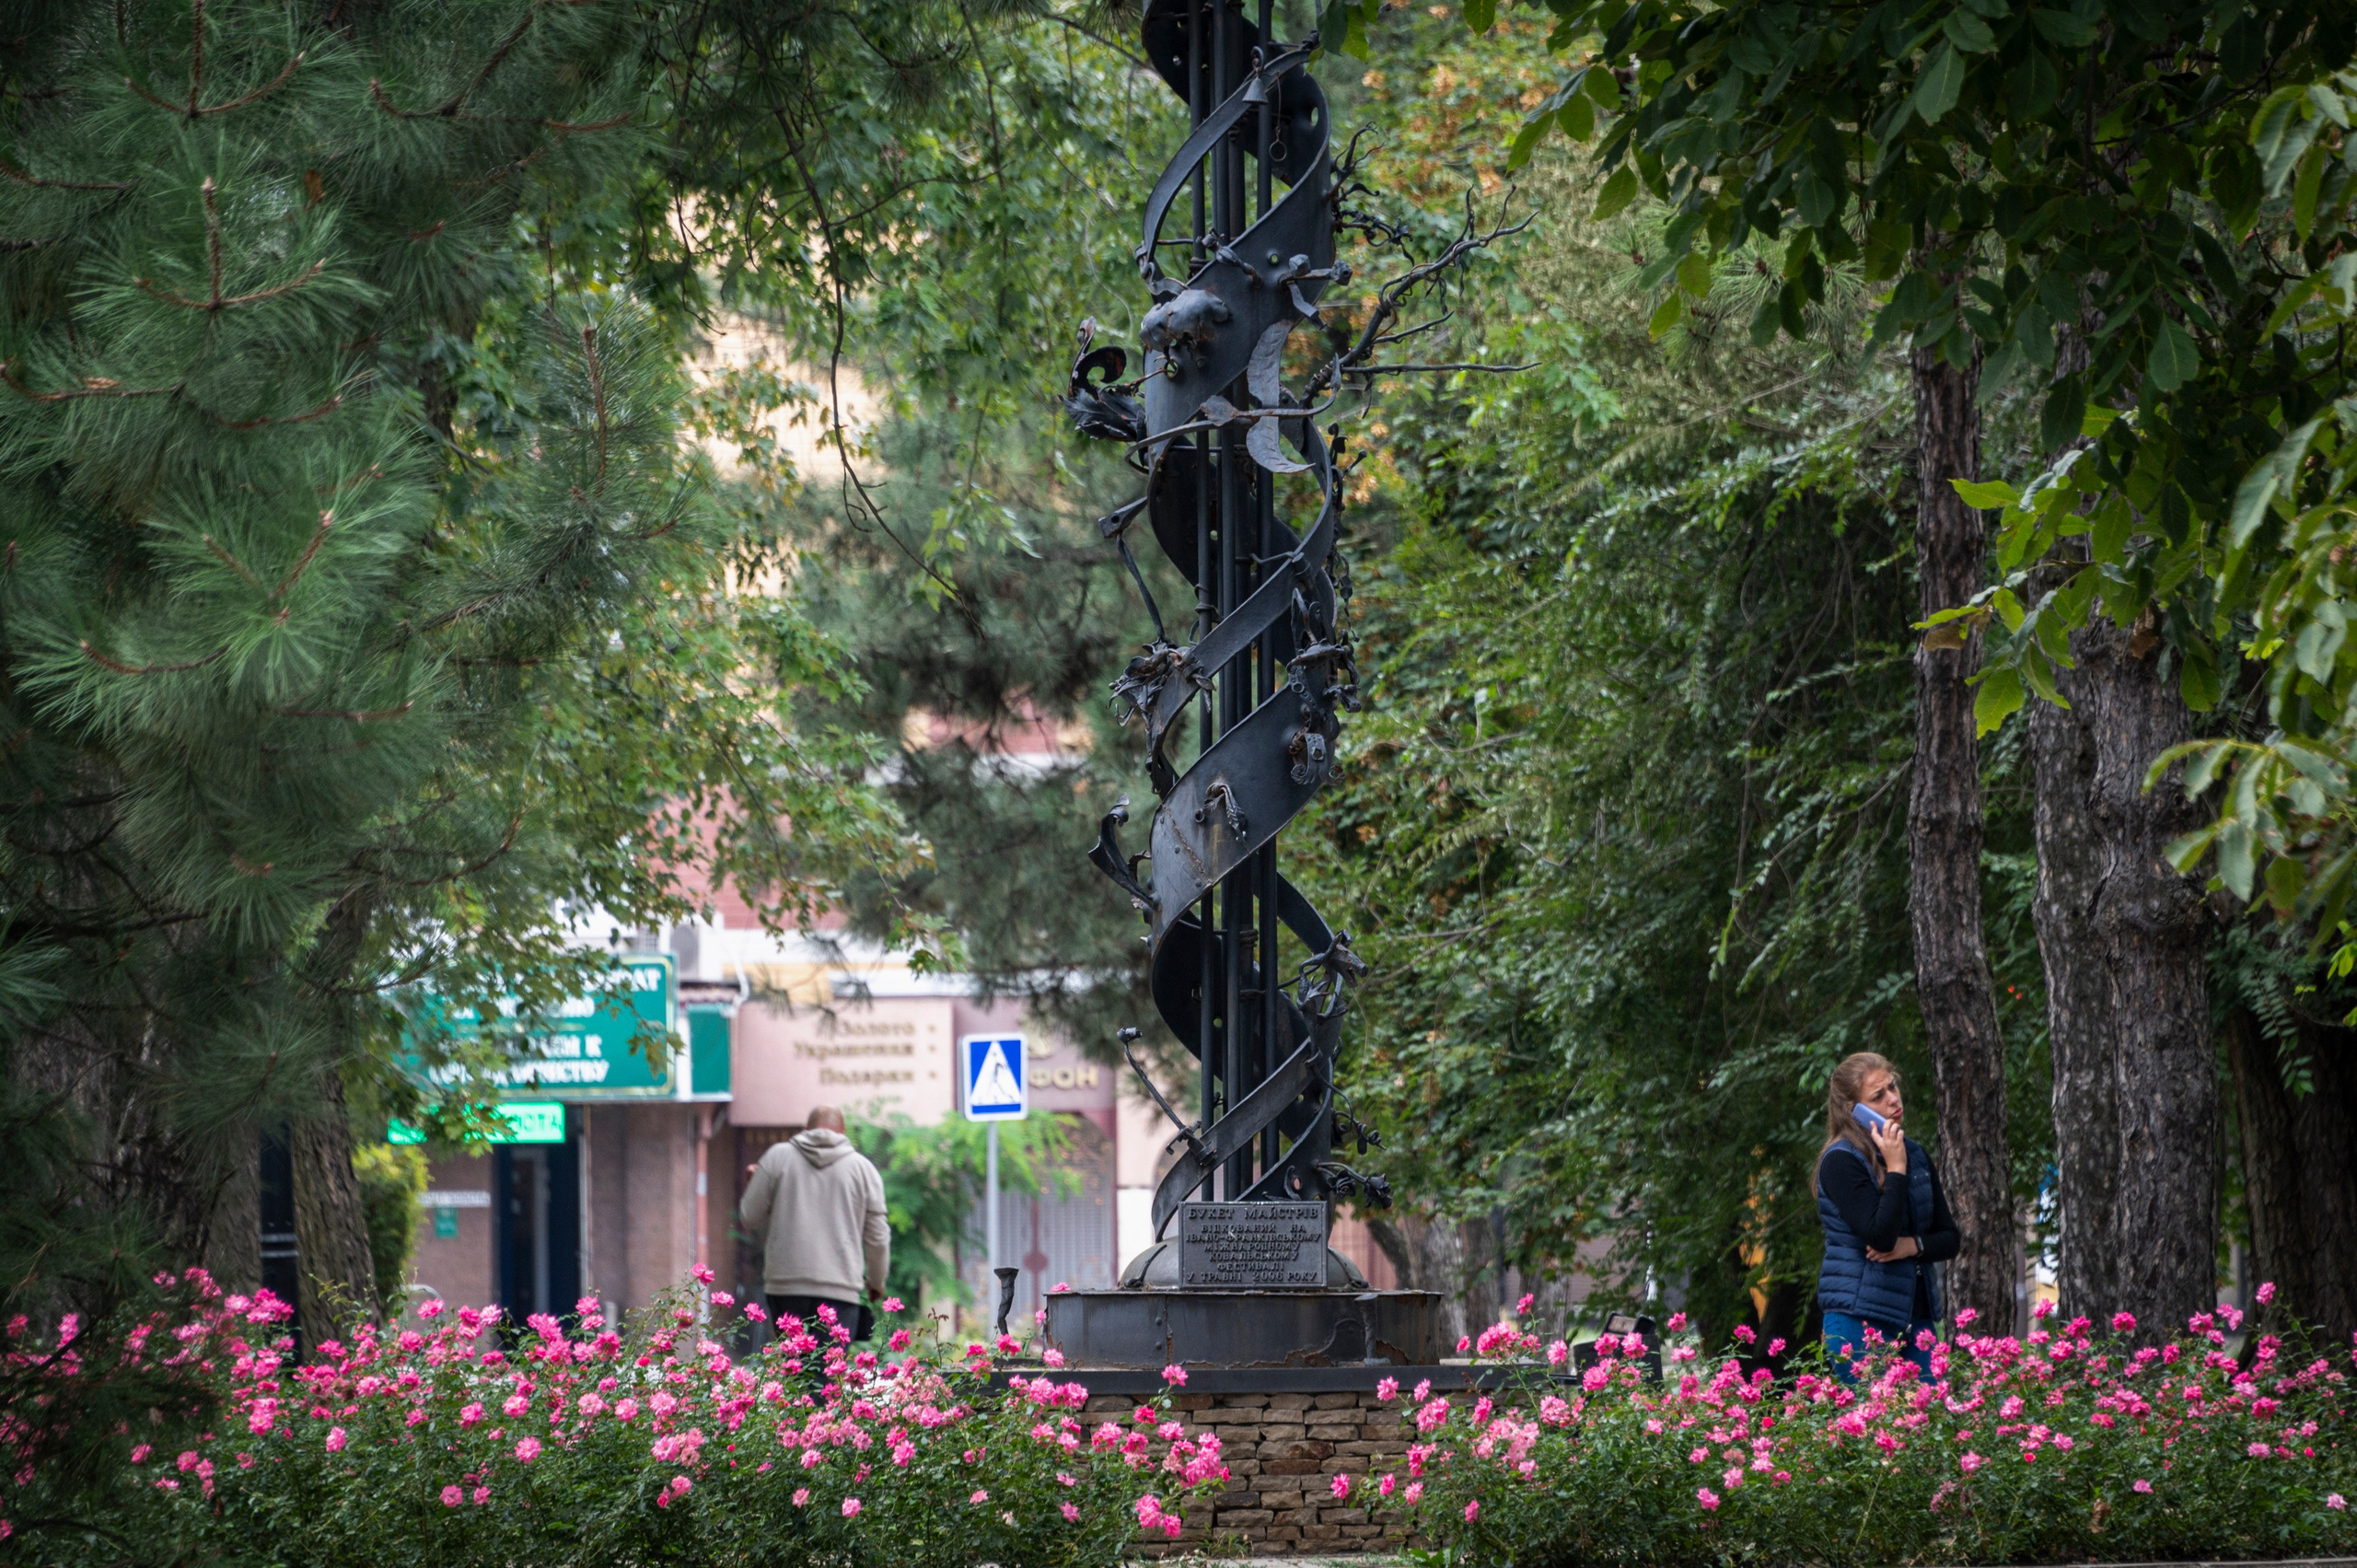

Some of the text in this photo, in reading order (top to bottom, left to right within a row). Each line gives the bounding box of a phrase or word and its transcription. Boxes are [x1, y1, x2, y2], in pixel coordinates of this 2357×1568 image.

[1028, 1065, 1099, 1089] ФОН
[1189, 1206, 1318, 1220] БУКЕТ МАЙСТРІВ
[1201, 1224, 1306, 1234] ВІДКОВАНИЙ НА
[1186, 1234, 1321, 1243] ІВАНО-ФРАНКІВСЬКОМУ
[1204, 1242, 1301, 1252] МІЖНАРОДНОМУ
[1209, 1252, 1299, 1261] КОВАЛЬСЬКОМУ
[1217, 1262, 1284, 1272] ФЕСТИВАЛІ
[1187, 1272, 1318, 1283] У ТРАВНІ 2006 РОКУ
